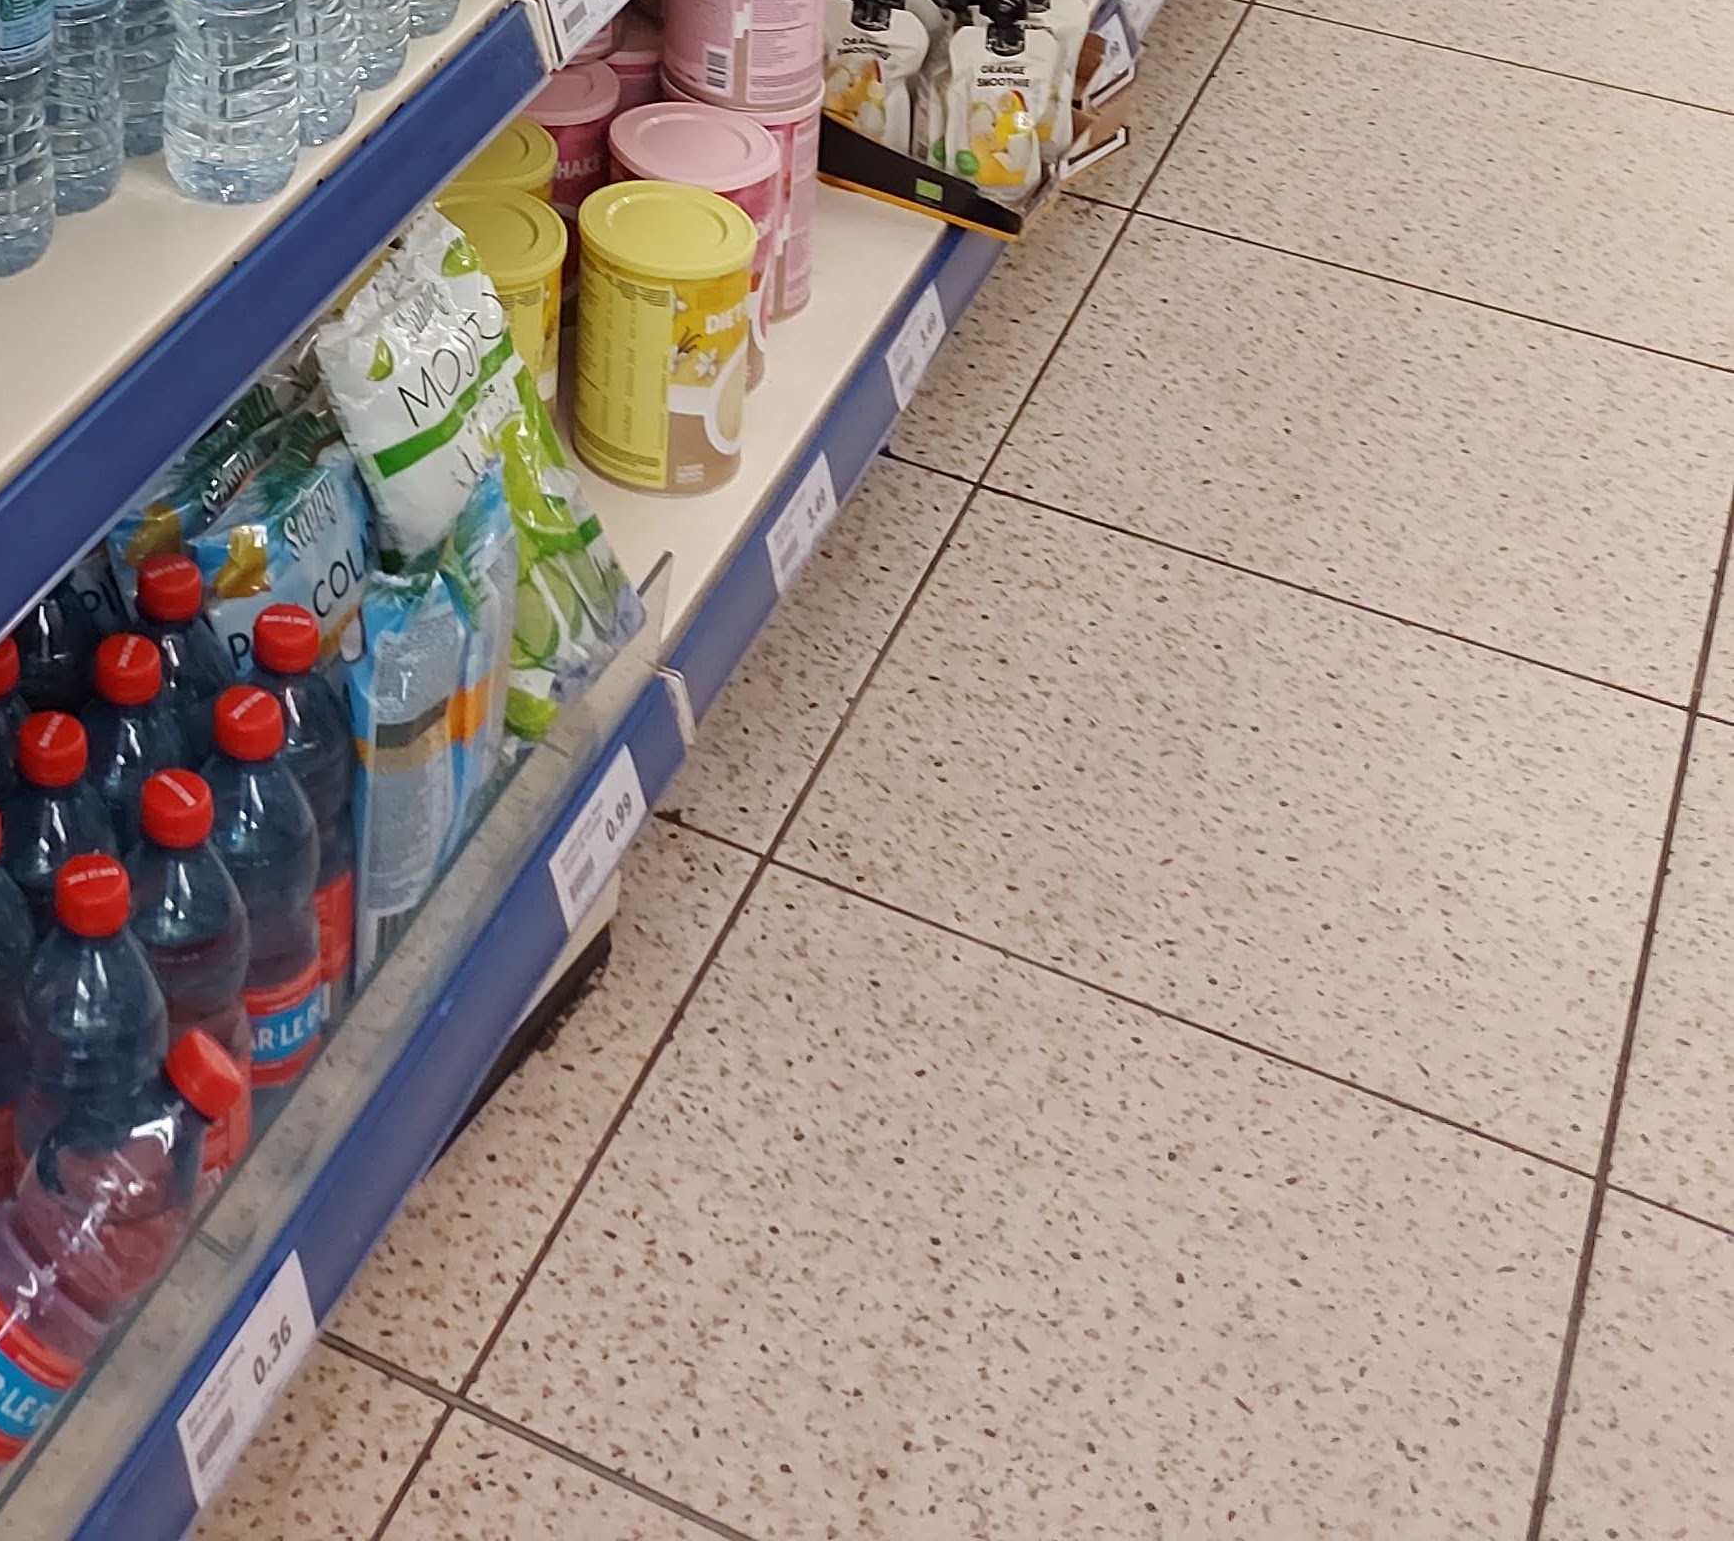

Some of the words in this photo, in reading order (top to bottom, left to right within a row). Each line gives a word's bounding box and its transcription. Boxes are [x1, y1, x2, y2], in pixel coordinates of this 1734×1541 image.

[980, 62, 1025, 77] ORANGE
[977, 75, 1030, 89] SMOOTHIE
[606, 791, 633, 843] 0.99
